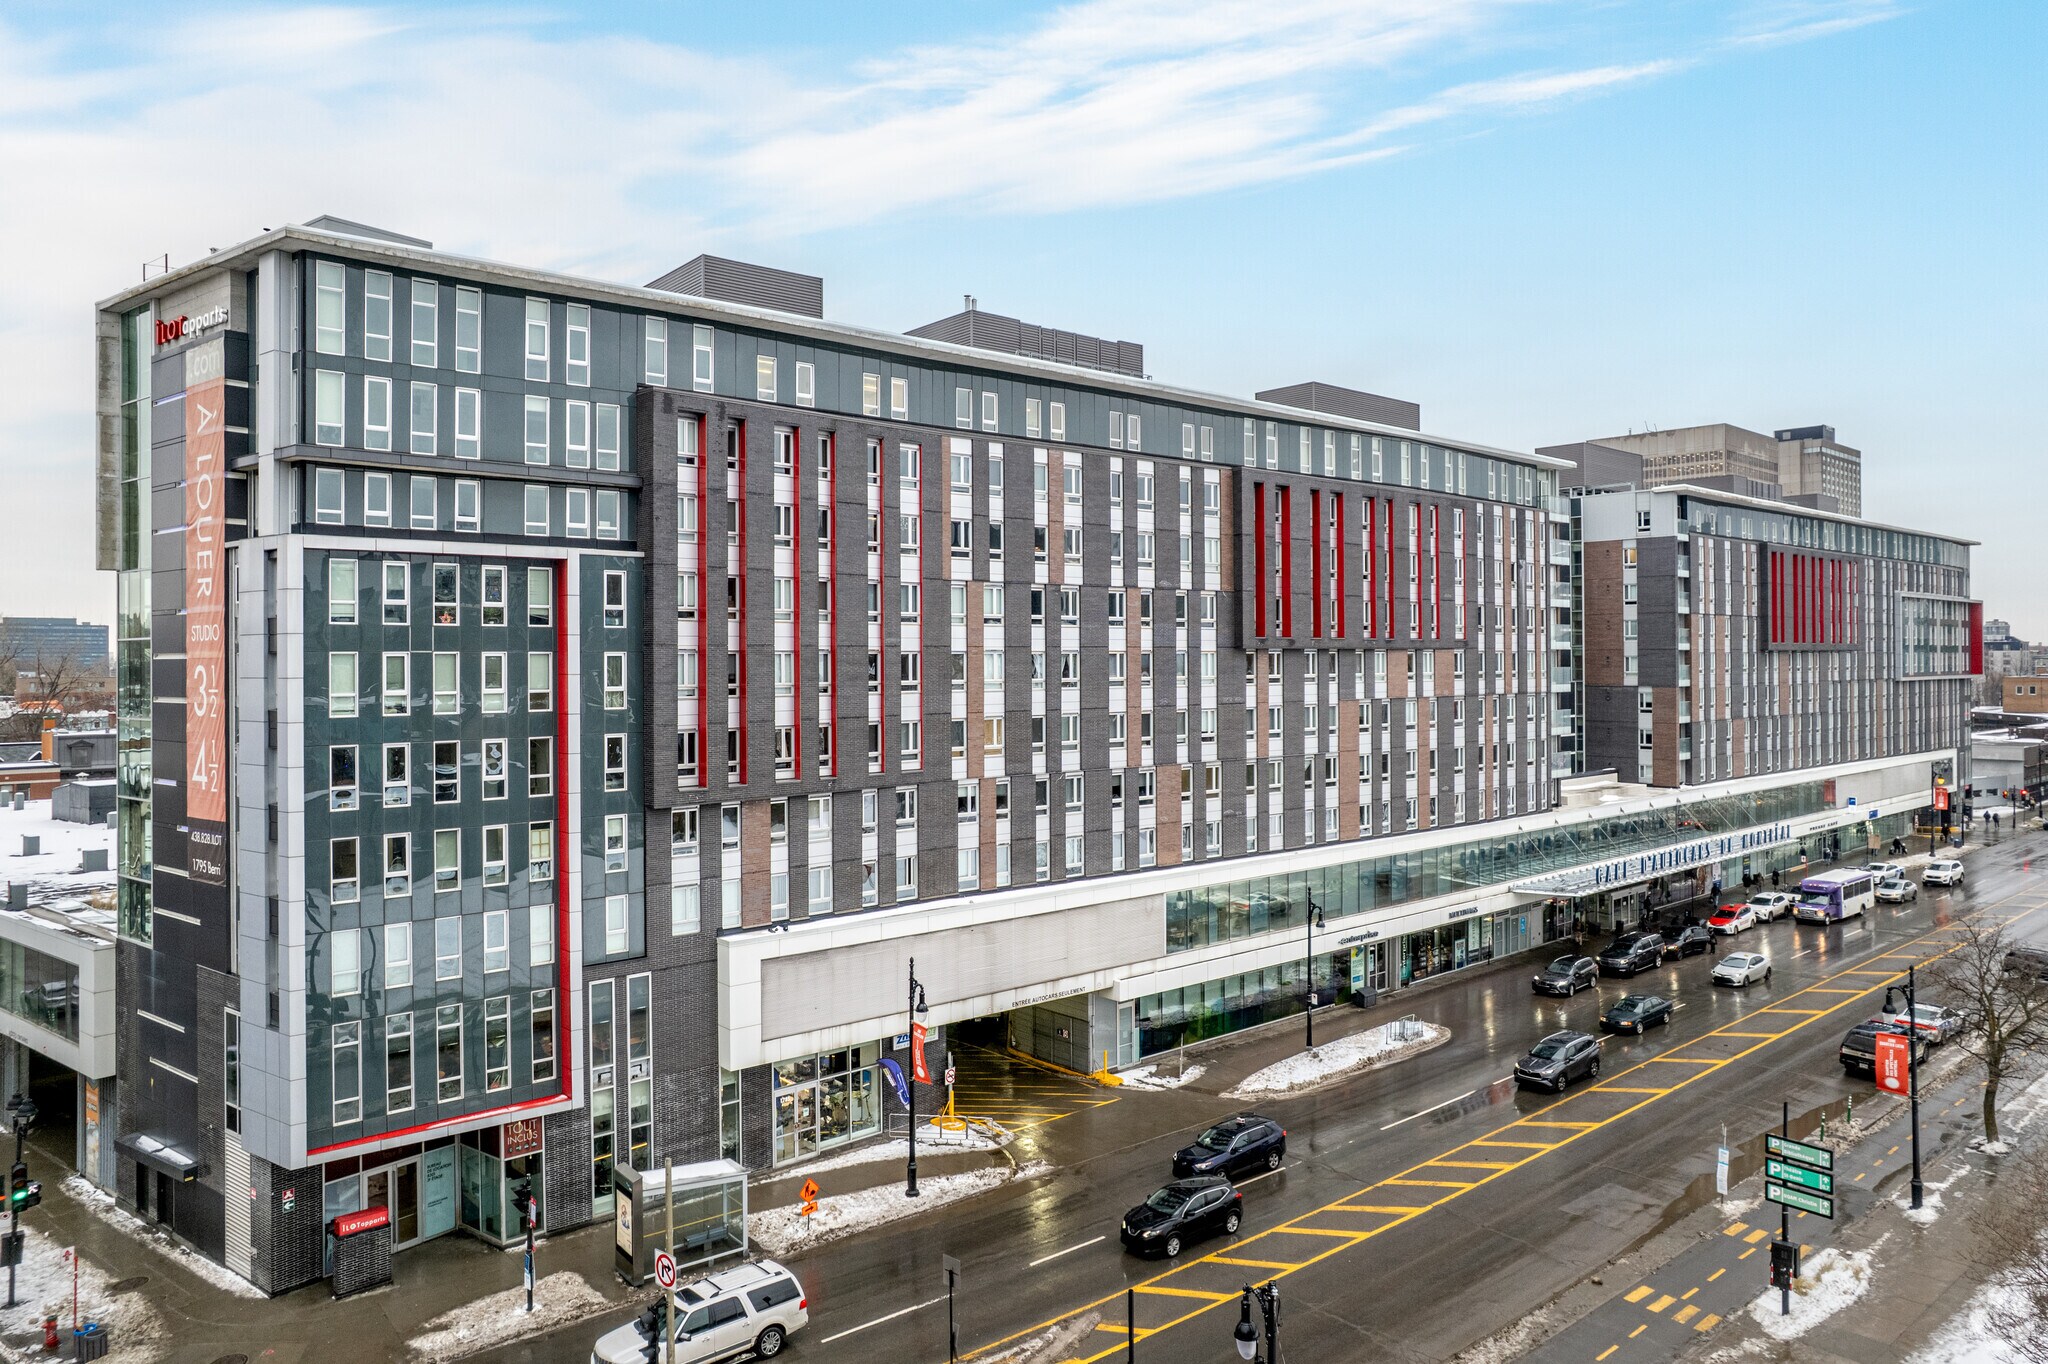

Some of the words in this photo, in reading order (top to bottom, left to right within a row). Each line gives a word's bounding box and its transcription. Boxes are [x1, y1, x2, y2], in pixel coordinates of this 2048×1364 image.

[196, 403, 217, 434] À
[196, 454, 212, 598] LOUER
[191, 624, 220, 642] STUDIO
[192, 858, 207, 873] 1795
[207, 861, 221, 875] Berri
[1011, 998, 1031, 1008] ENTRÉE
[1032, 992, 1057, 1003] AUTOCARS
[1058, 986, 1086, 998] SEULEMENT
[506, 1119, 537, 1135] TOUT
[507, 1130, 538, 1145] INCLUS
[1771, 1139, 1780, 1148] P
[1770, 1162, 1781, 1175] P
[1770, 1186, 1781, 1199] P
